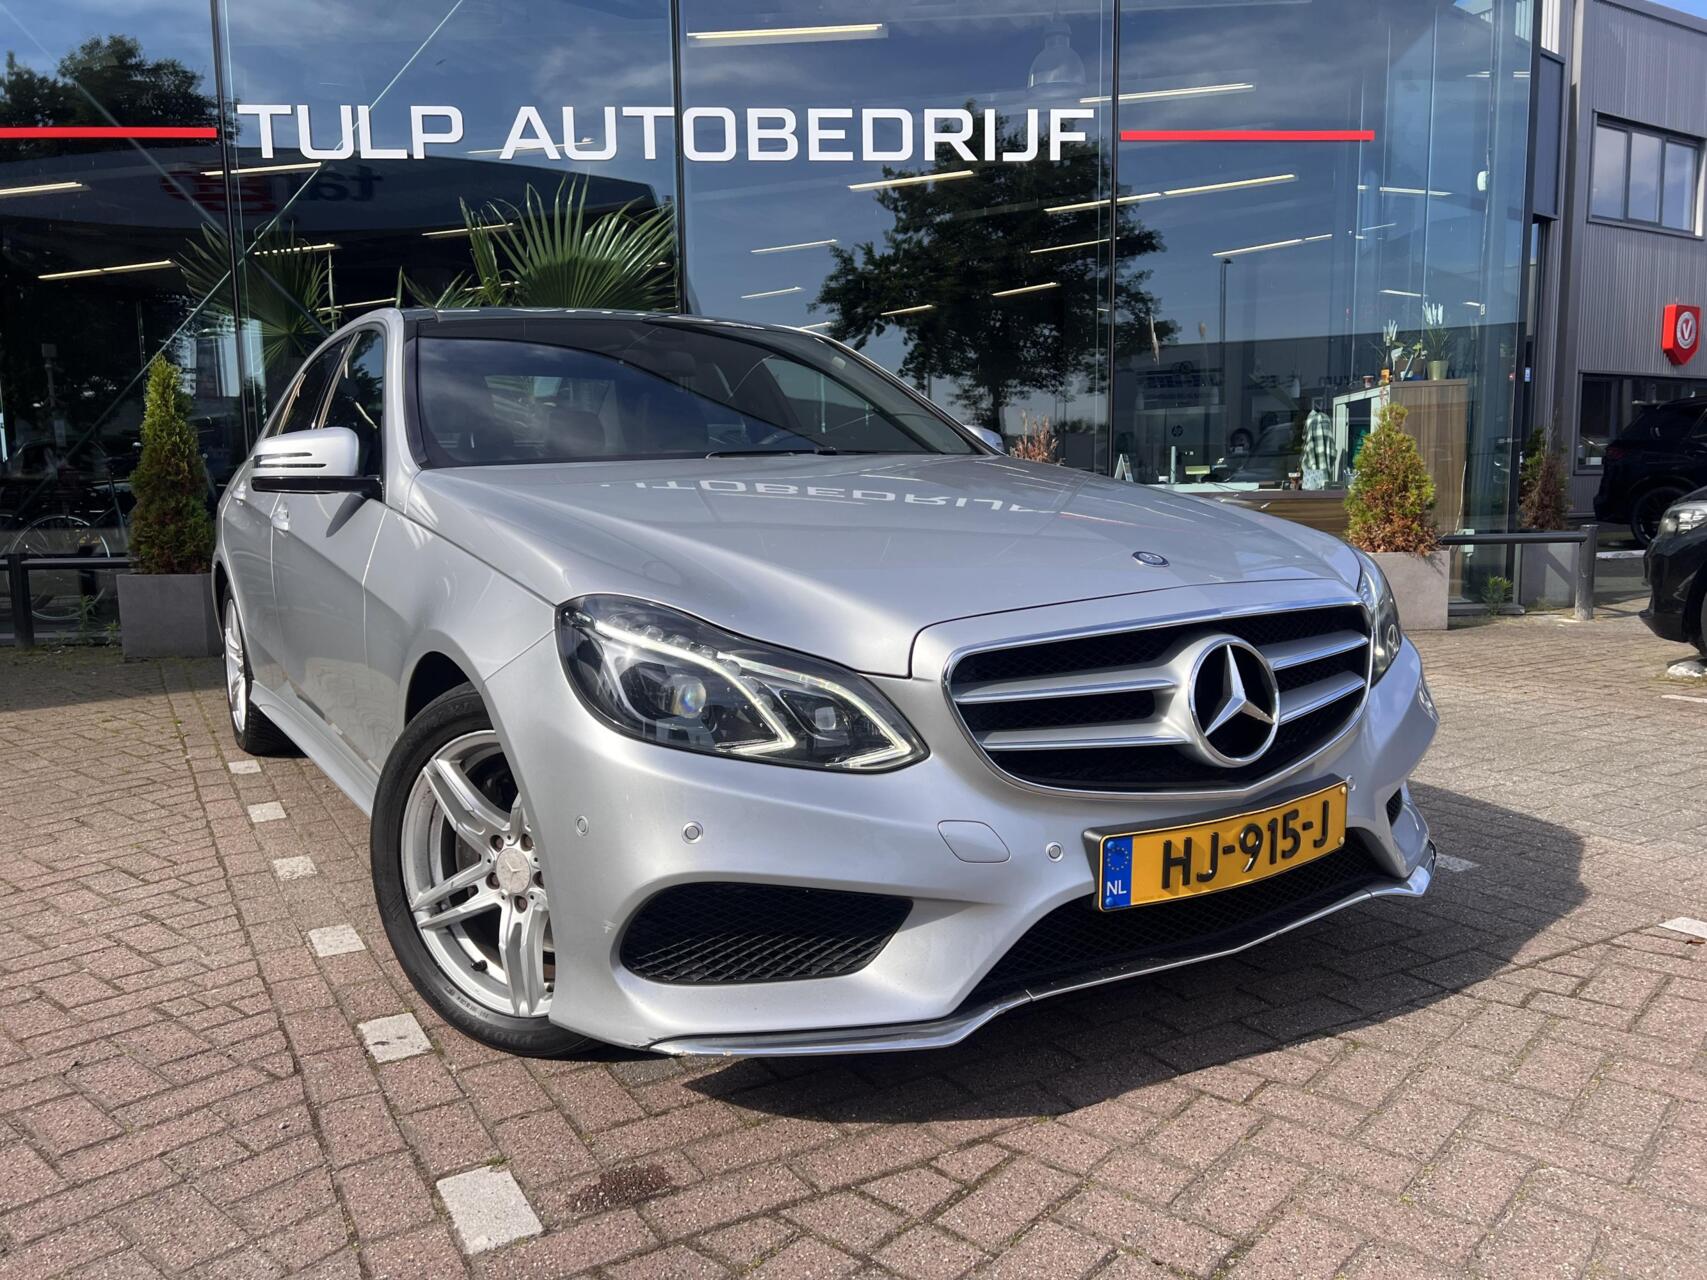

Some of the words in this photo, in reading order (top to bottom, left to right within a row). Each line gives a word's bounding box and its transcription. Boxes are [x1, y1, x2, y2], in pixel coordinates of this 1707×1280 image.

[237, 104, 464, 160] TULP
[500, 106, 1095, 162] AUTOBEDRIJF
[1106, 880, 1127, 895] NL
[1161, 800, 1330, 890] HJ-915-J
